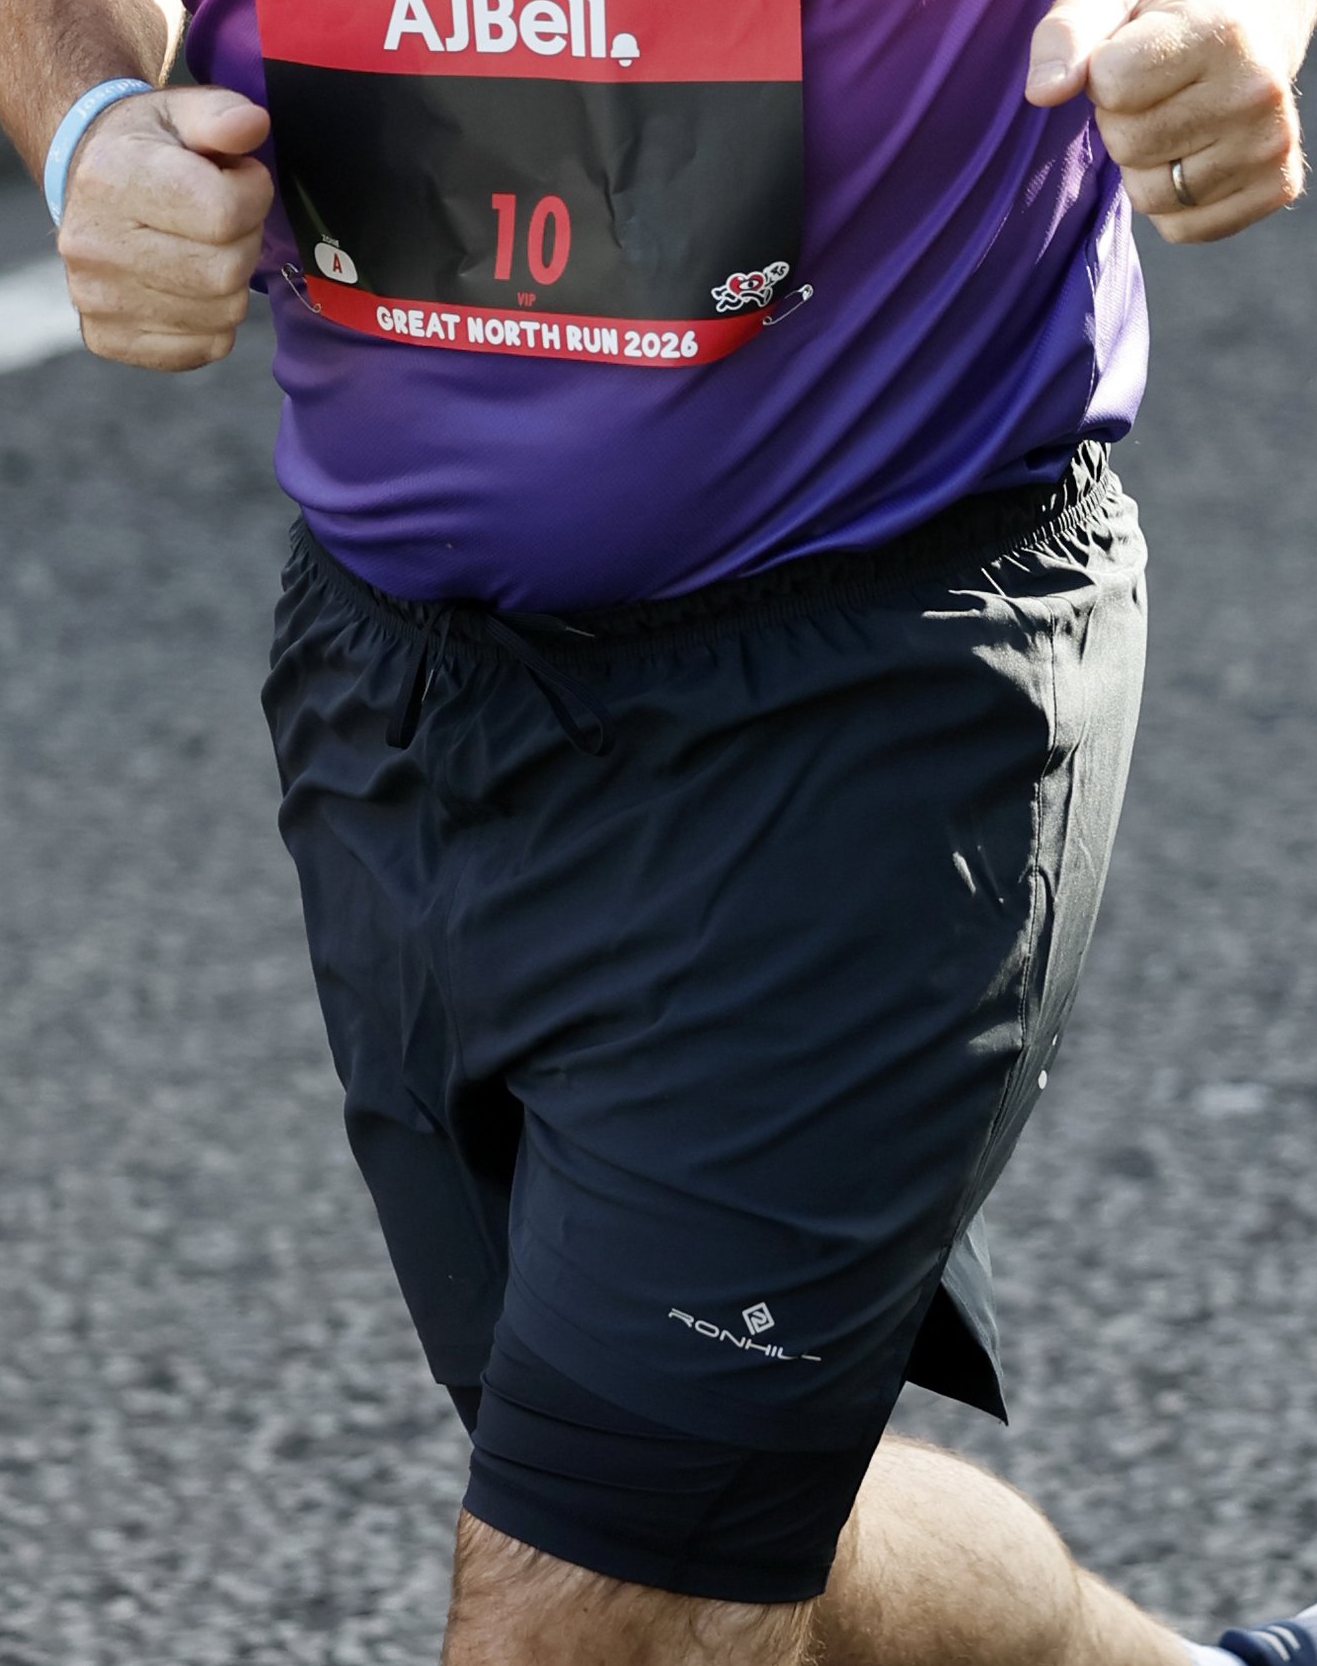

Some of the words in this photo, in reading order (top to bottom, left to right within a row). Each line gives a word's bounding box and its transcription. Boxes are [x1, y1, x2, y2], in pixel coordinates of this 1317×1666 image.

[491, 192, 572, 285] 10
[332, 253, 343, 274] A
[770, 265, 786, 277] 45
[516, 292, 536, 308] VIP
[376, 305, 461, 341] GREAT
[466, 316, 561, 350] NORTH
[566, 323, 619, 356] RUN
[623, 330, 699, 360] 2026
